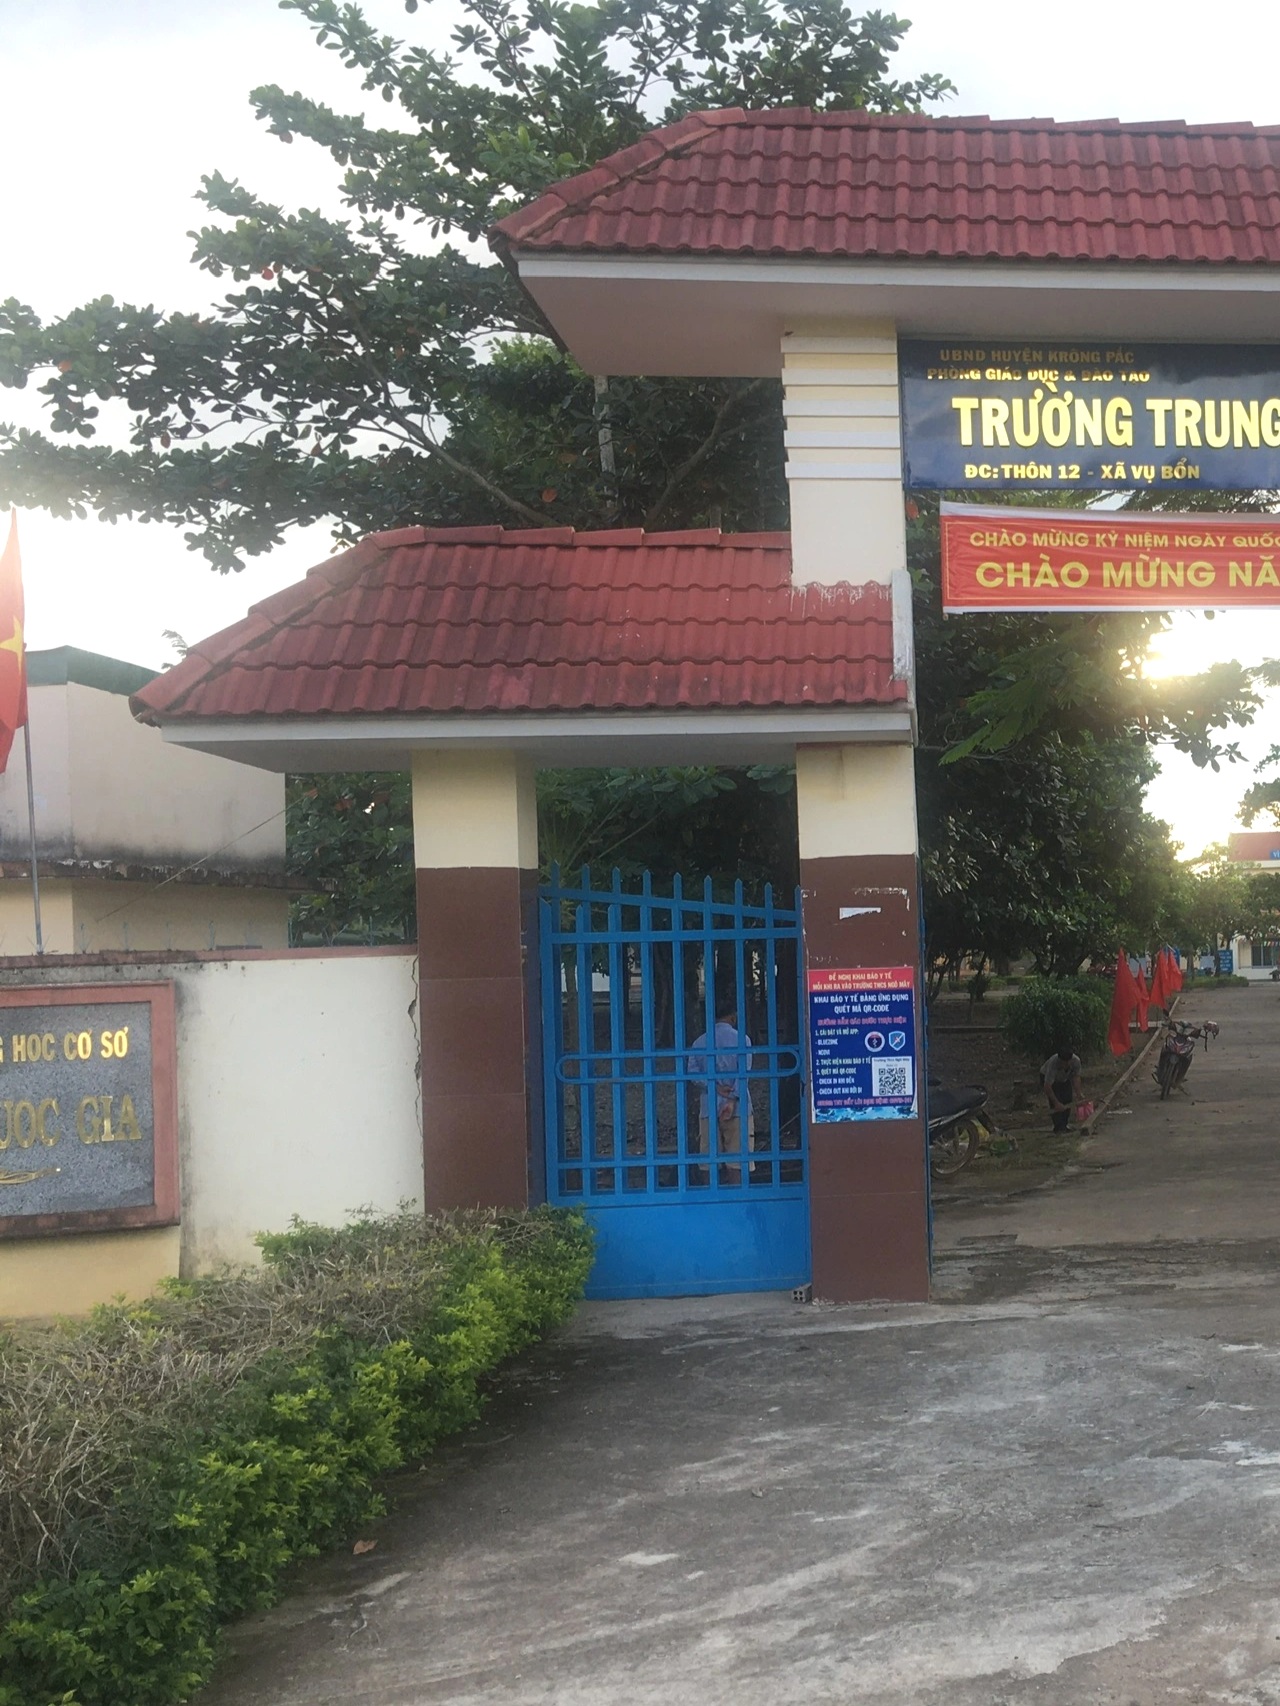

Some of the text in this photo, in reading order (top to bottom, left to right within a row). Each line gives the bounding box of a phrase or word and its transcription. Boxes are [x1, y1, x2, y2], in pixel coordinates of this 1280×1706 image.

[940, 346, 1134, 364] UBND HUYỆN KRÔNG PẮC
[927, 365, 981, 380] PHÒNG
[985, 366, 1022, 381] GIÁO
[1027, 367, 1059, 383] DỤC
[1120, 369, 1150, 384] TẠO
[951, 382, 1133, 448] TRƯỜNG
[1058, 464, 1080, 478] 12
[1101, 462, 1126, 479] XÃ
[1131, 465, 1155, 483] VỤ
[969, 531, 1027, 548] CHÀO
[1032, 528, 1089, 548] MỪNG
[1124, 531, 1169, 552] NIỆM
[1174, 532, 1227, 548] NGÀY
[975, 553, 1090, 589] CHÀO
[1102, 553, 1217, 588] MỪNG
[831, 993, 843, 1003] BÁO
[850, 992, 859, 1002] TẾ
[860, 992, 877, 1002] BẰNG
[878, 992, 891, 1001] ỨNG
[892, 994, 909, 1002] DỤNG
[834, 1004, 889, 1014] QUÉT MÃ QR-CODE
[63, 1028, 92, 1060] CƠ
[77, 1094, 142, 1145] GIA
